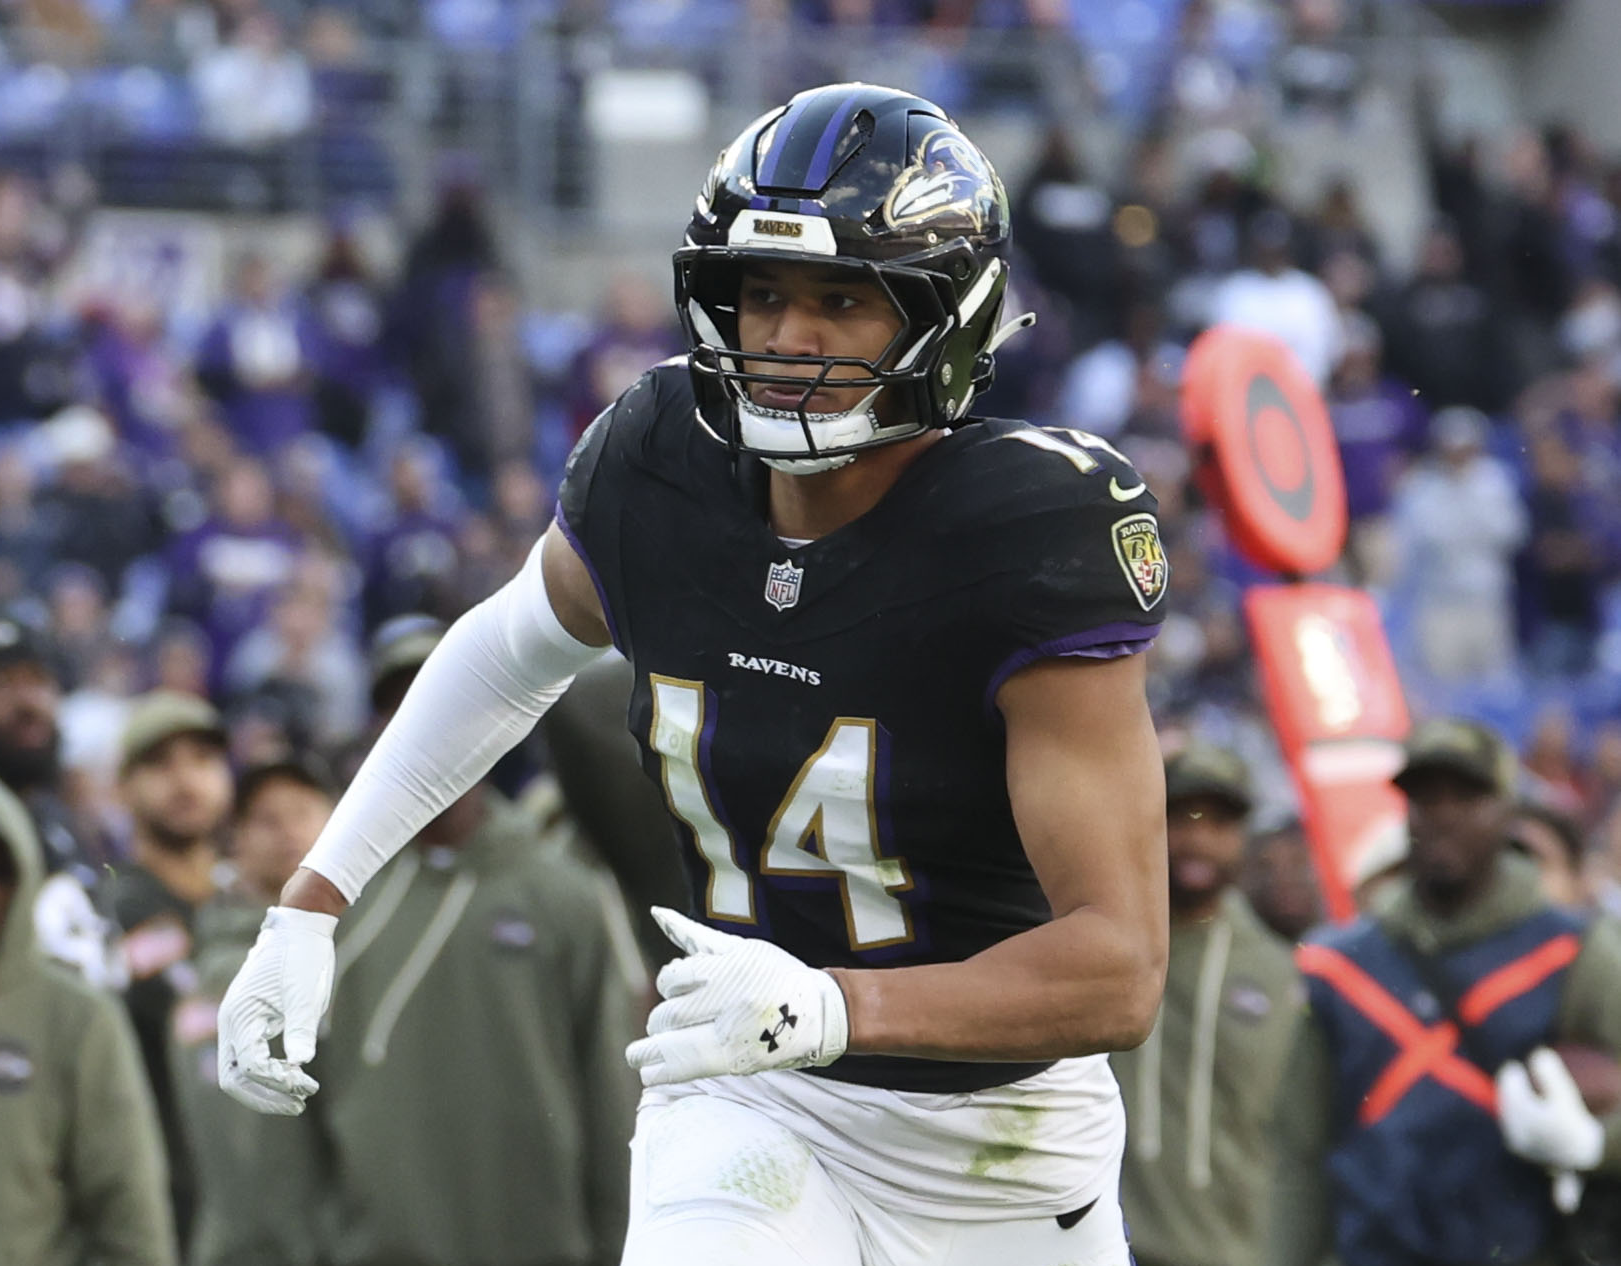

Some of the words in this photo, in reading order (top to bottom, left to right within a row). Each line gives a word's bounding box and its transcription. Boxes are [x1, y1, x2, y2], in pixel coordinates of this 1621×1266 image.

[753, 219, 804, 238] RAVENS
[770, 581, 795, 601] NFL
[728, 652, 821, 686] RAVENS
[650, 672, 915, 952] 14
